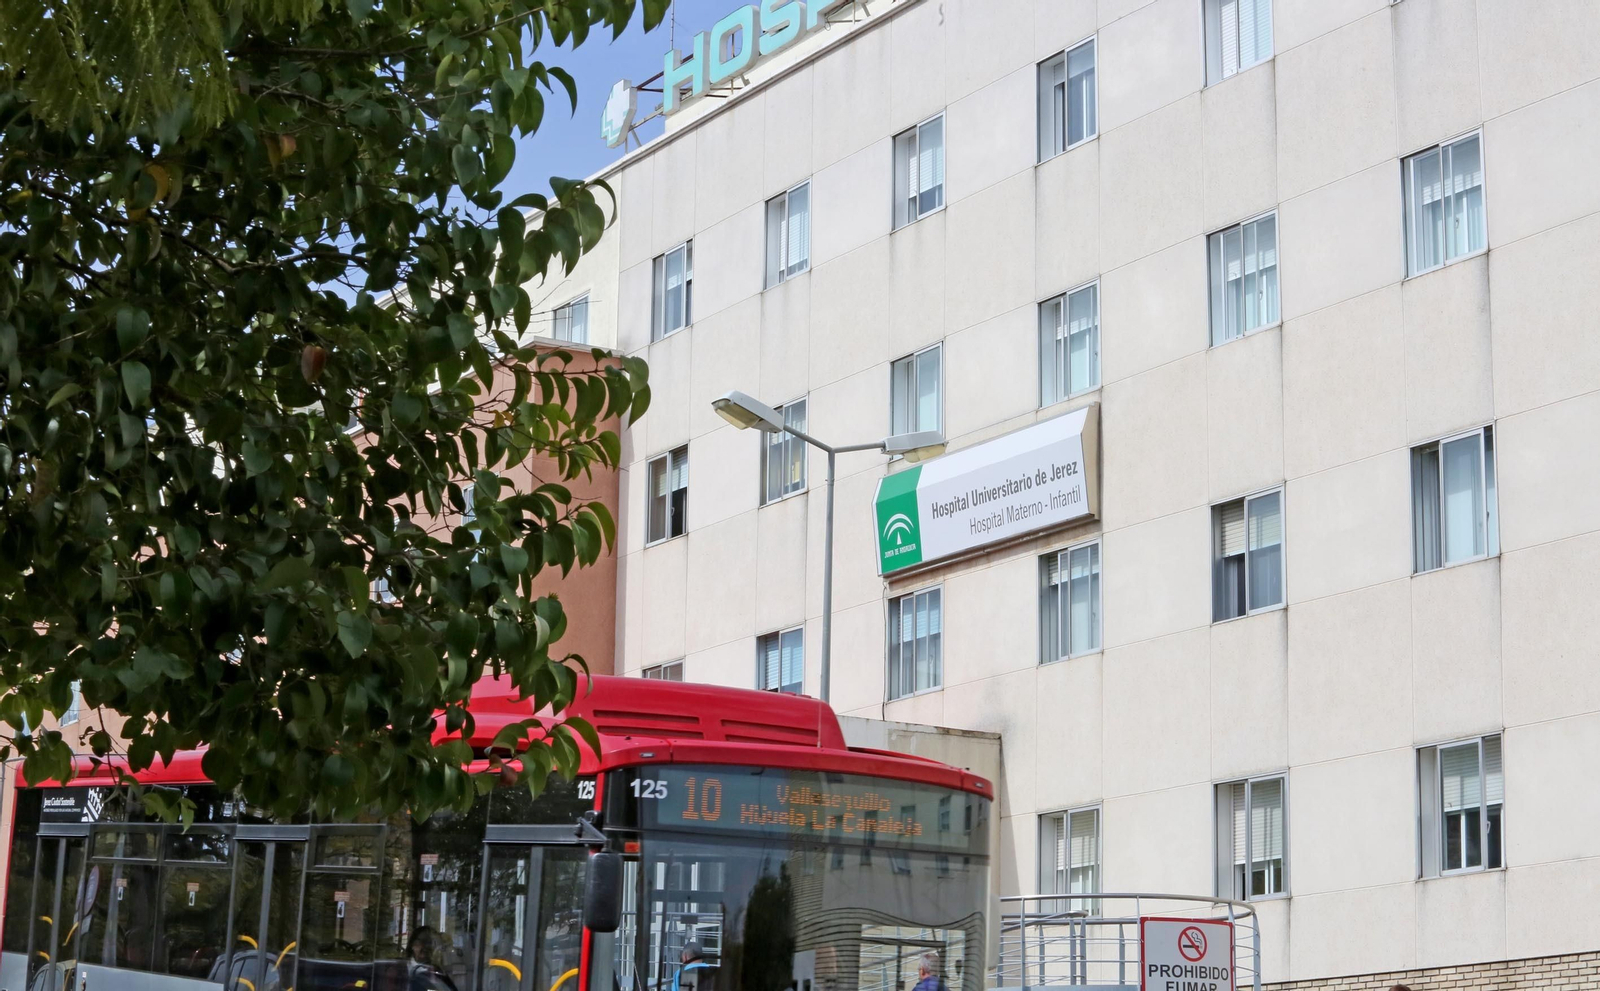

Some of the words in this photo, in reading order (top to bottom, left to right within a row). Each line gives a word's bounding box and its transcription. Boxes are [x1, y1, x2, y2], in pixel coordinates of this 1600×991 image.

[931, 491, 970, 520] Hospital
[971, 473, 1033, 507] Universitario
[1034, 468, 1047, 487] de
[1049, 461, 1078, 482] Jerez
[969, 508, 1005, 535] Hospital
[1006, 501, 1043, 524] Materno
[1049, 484, 1082, 510] Infantil
[577, 780, 596, 800] 125
[630, 778, 668, 799] 125
[682, 776, 722, 821] 10
[740, 803, 806, 826] Hijuela
[811, 810, 836, 831] La
[843, 812, 922, 838] Canaleja
[1148, 964, 1229, 981] PROHIBIDO
[1165, 981, 1218, 991] FUMAR
